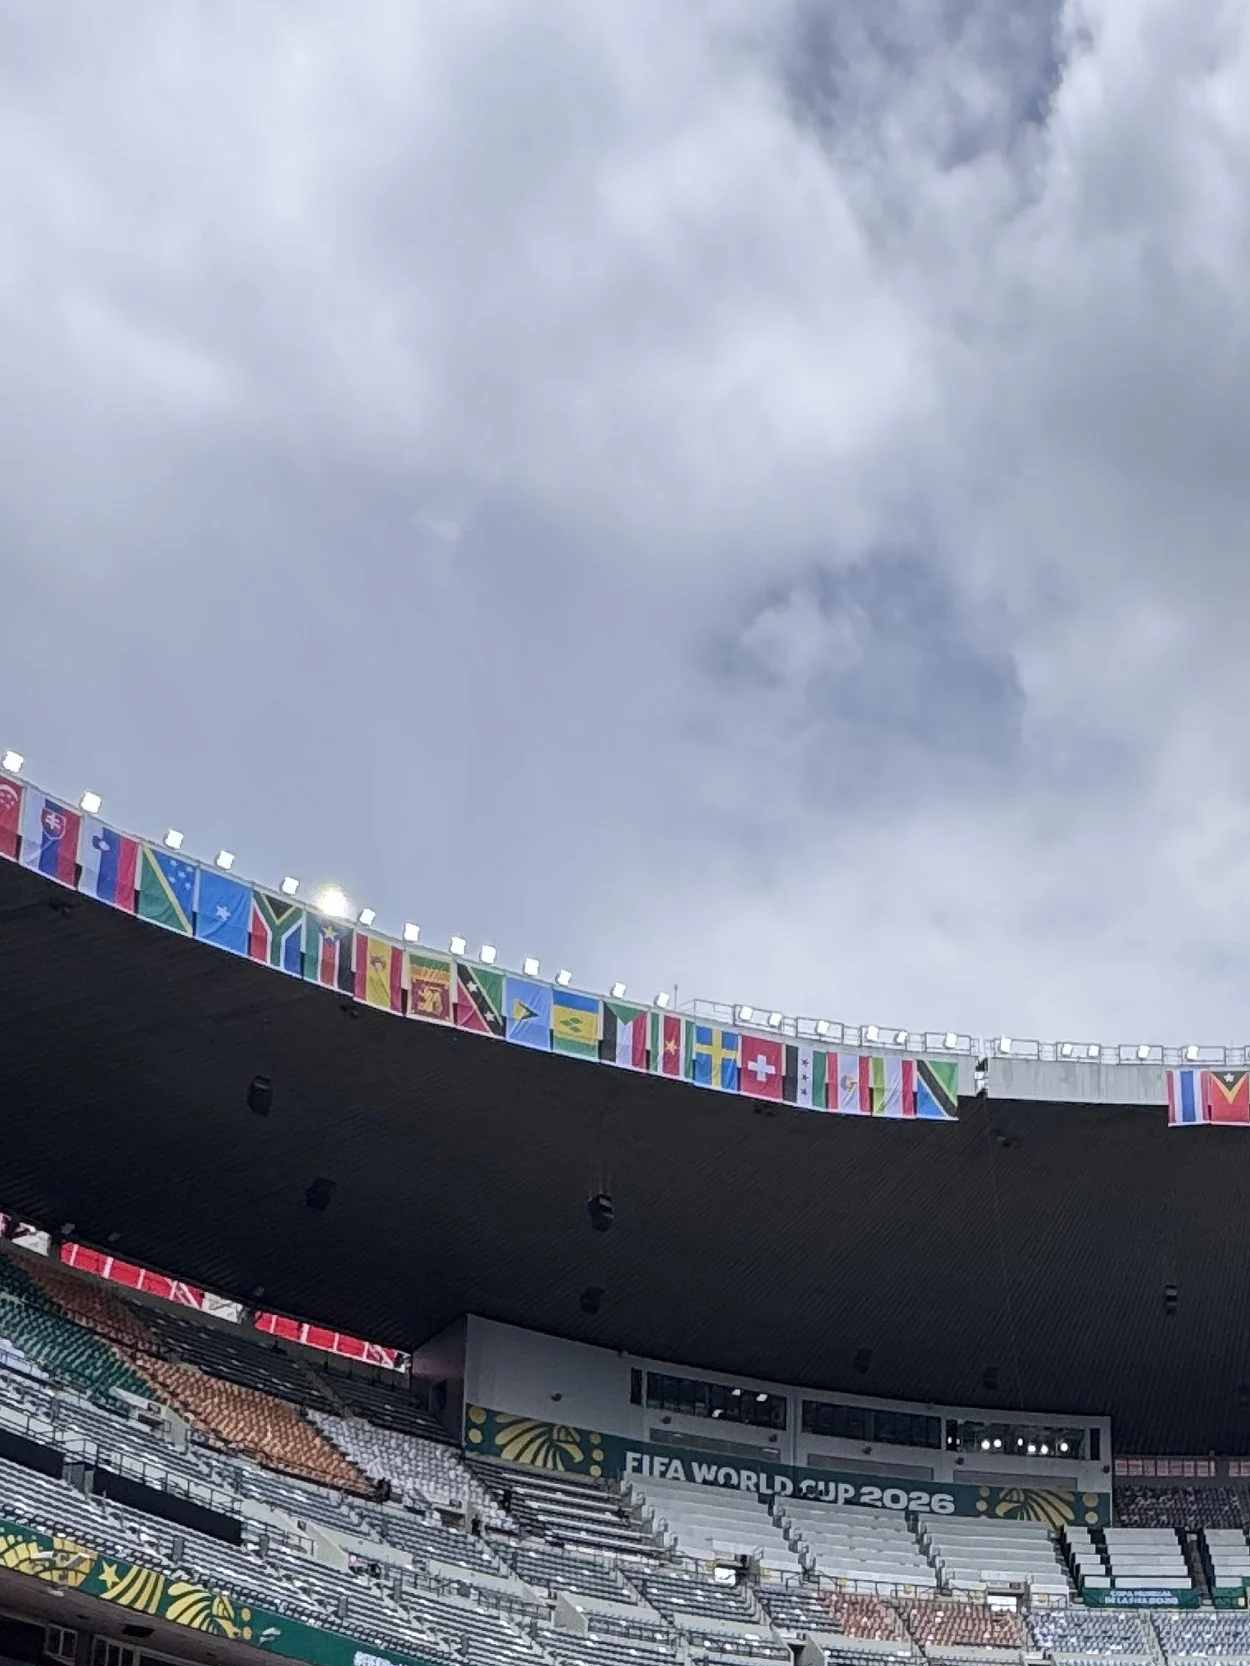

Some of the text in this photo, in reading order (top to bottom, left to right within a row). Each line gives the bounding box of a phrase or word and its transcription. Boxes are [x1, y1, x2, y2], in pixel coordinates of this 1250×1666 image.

[625, 1451, 955, 1514] FIFA WORLD CUP 2026
